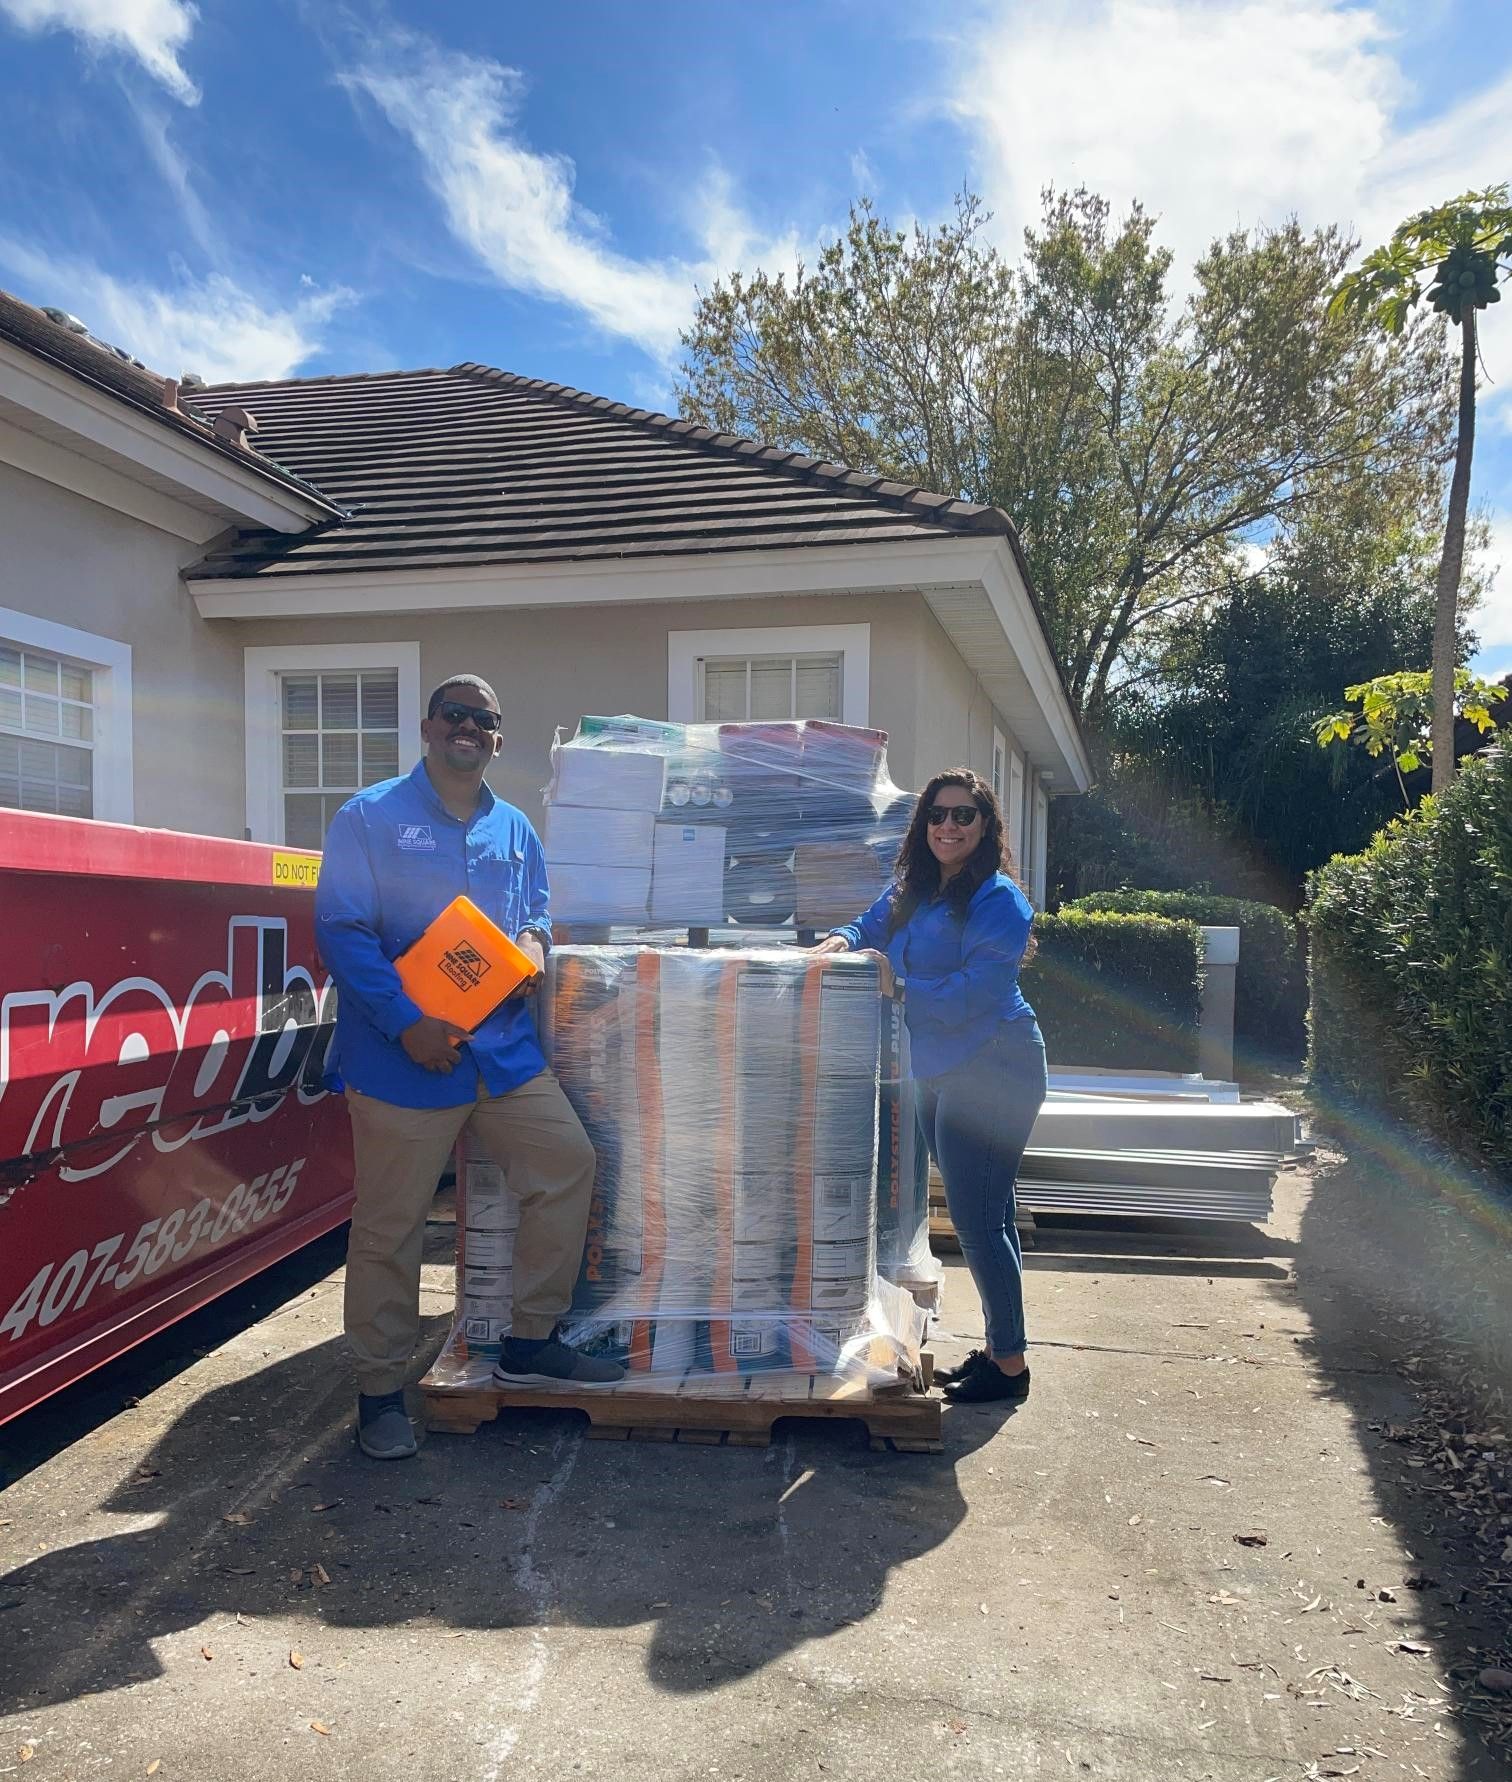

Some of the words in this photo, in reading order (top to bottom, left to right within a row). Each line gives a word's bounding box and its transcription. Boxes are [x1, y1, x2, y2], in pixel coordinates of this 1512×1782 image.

[275, 862, 289, 879] DO
[291, 864, 309, 880] NOT
[444, 962, 467, 987] Roofing
[456, 963, 480, 987] SQUARE
[890, 1003, 901, 1053] PLUS
[0, 1157, 306, 1341] 407-583-0555
